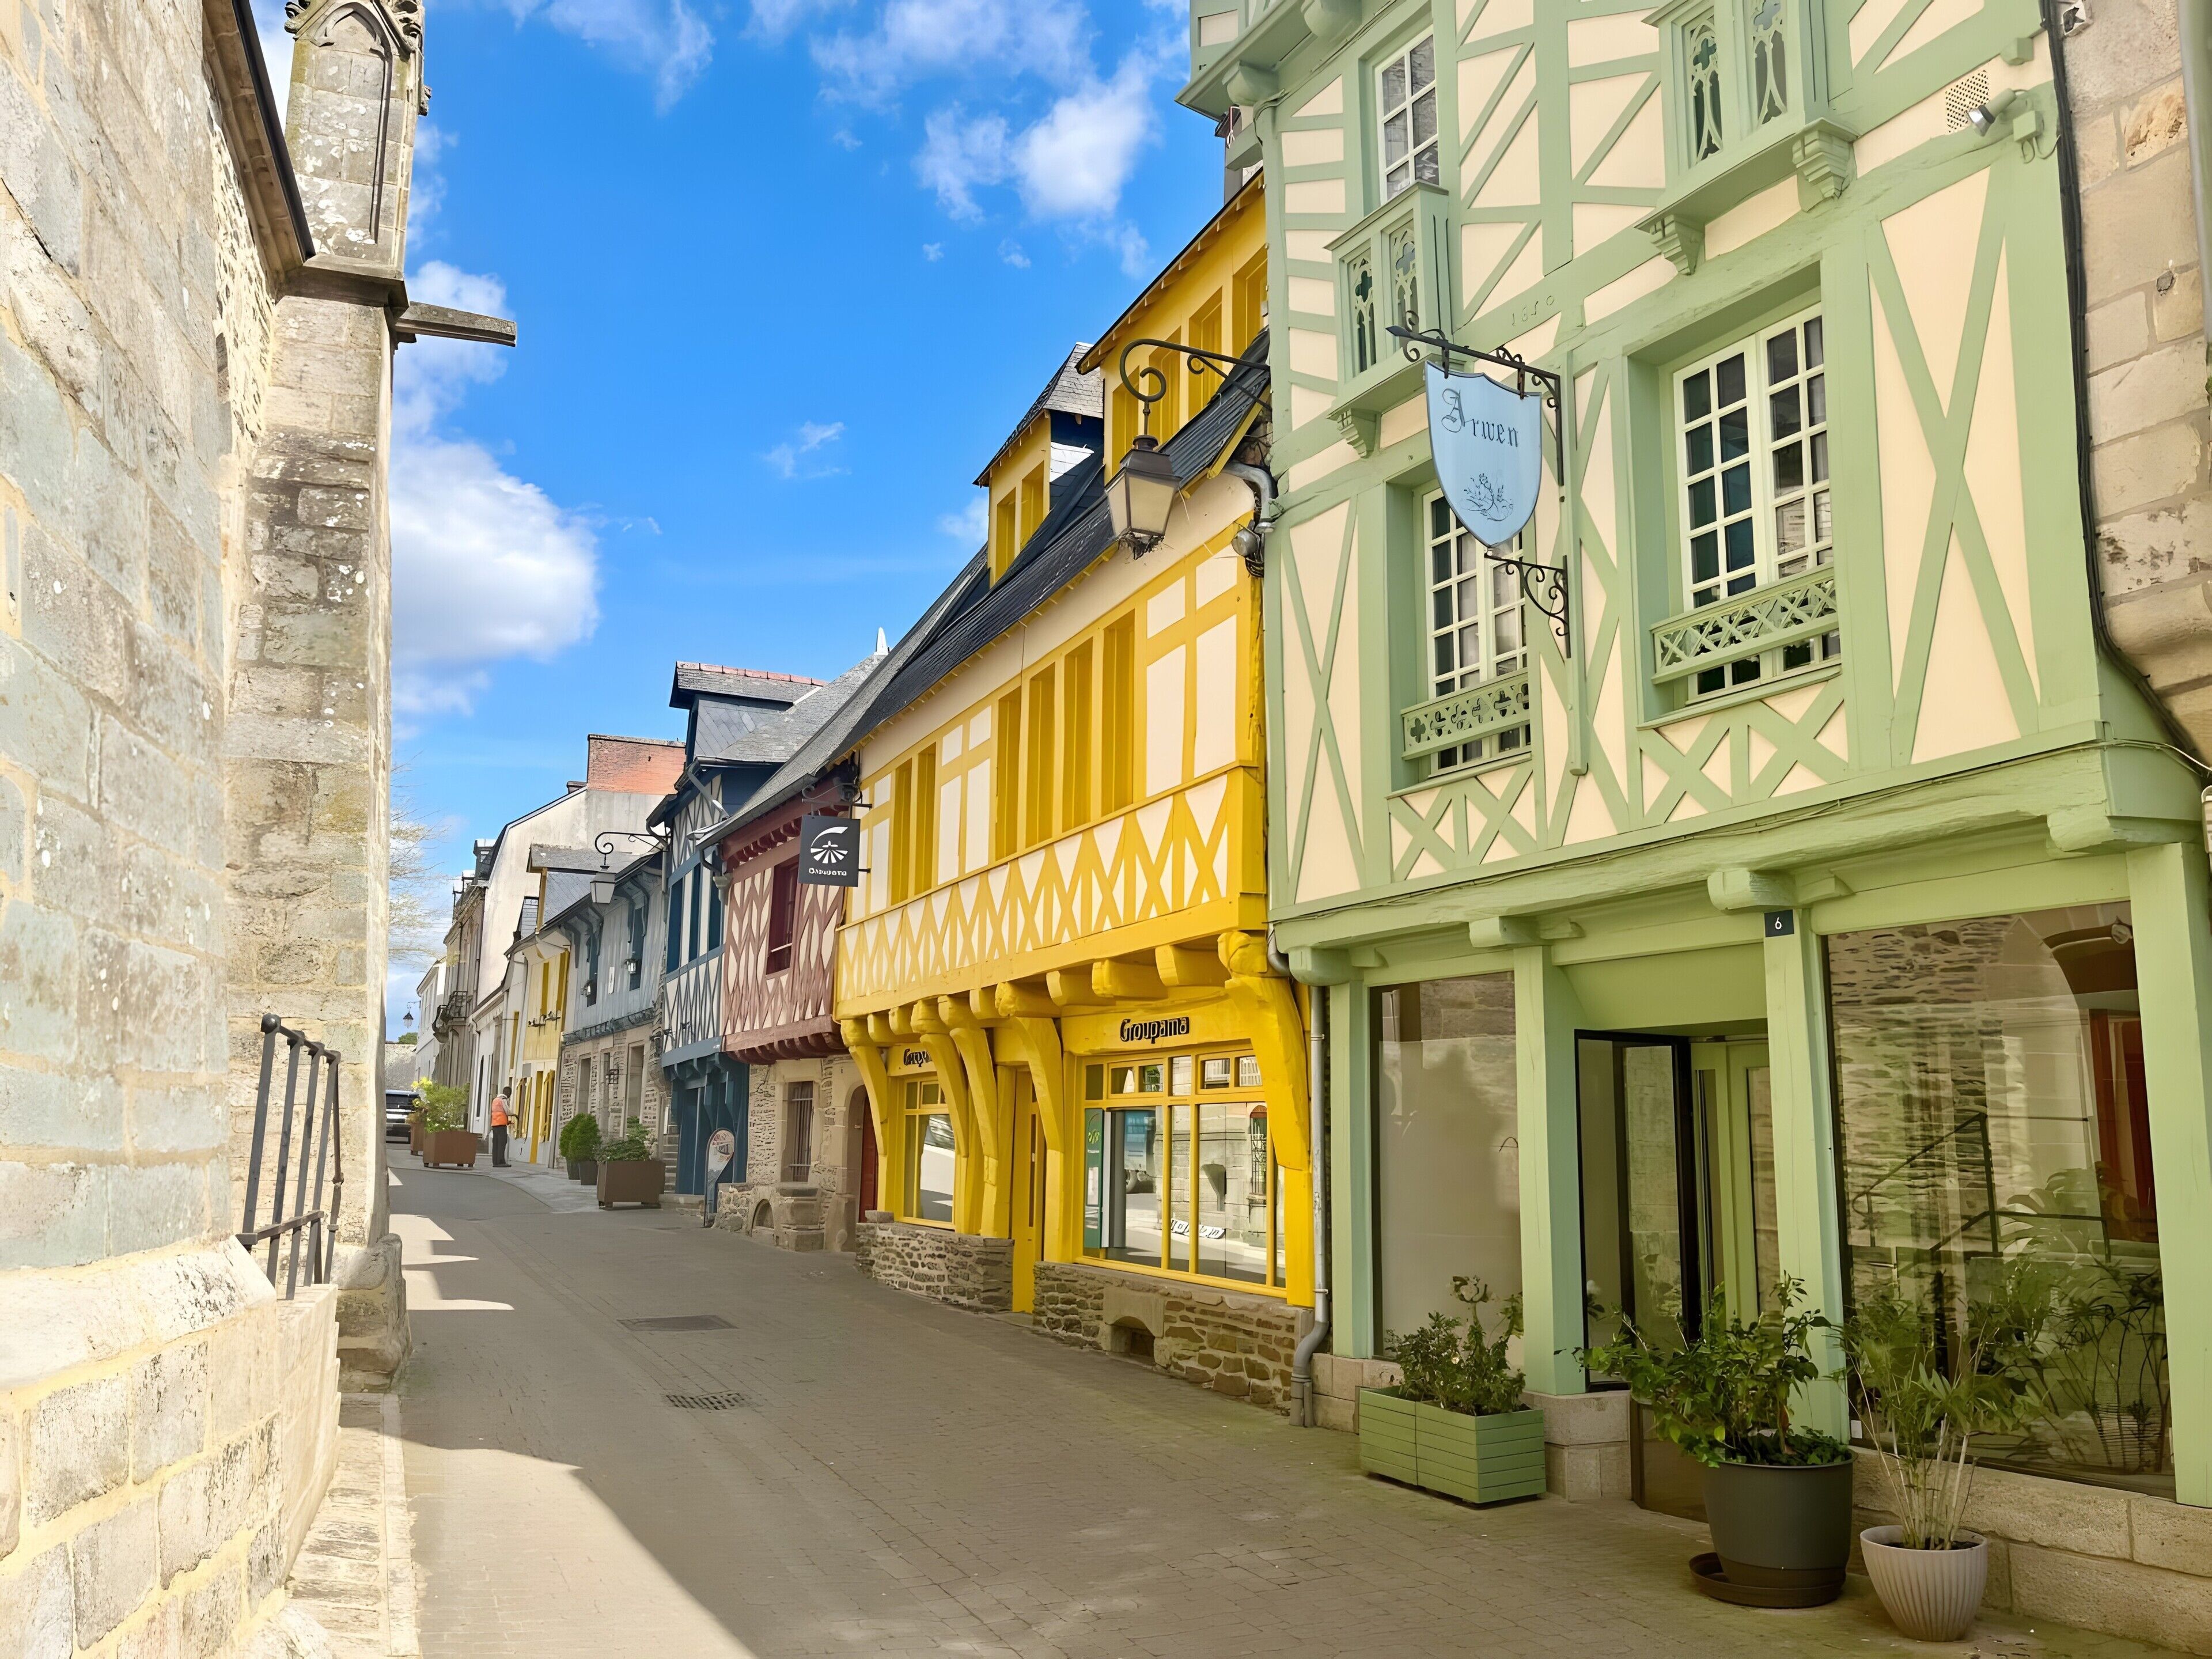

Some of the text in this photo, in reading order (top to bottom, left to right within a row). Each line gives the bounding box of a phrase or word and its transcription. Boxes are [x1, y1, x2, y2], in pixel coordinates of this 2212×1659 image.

[1441, 388, 1518, 447] Arwen
[1775, 916, 1782, 930] 6
[1120, 1017, 1190, 1044] Groupama
